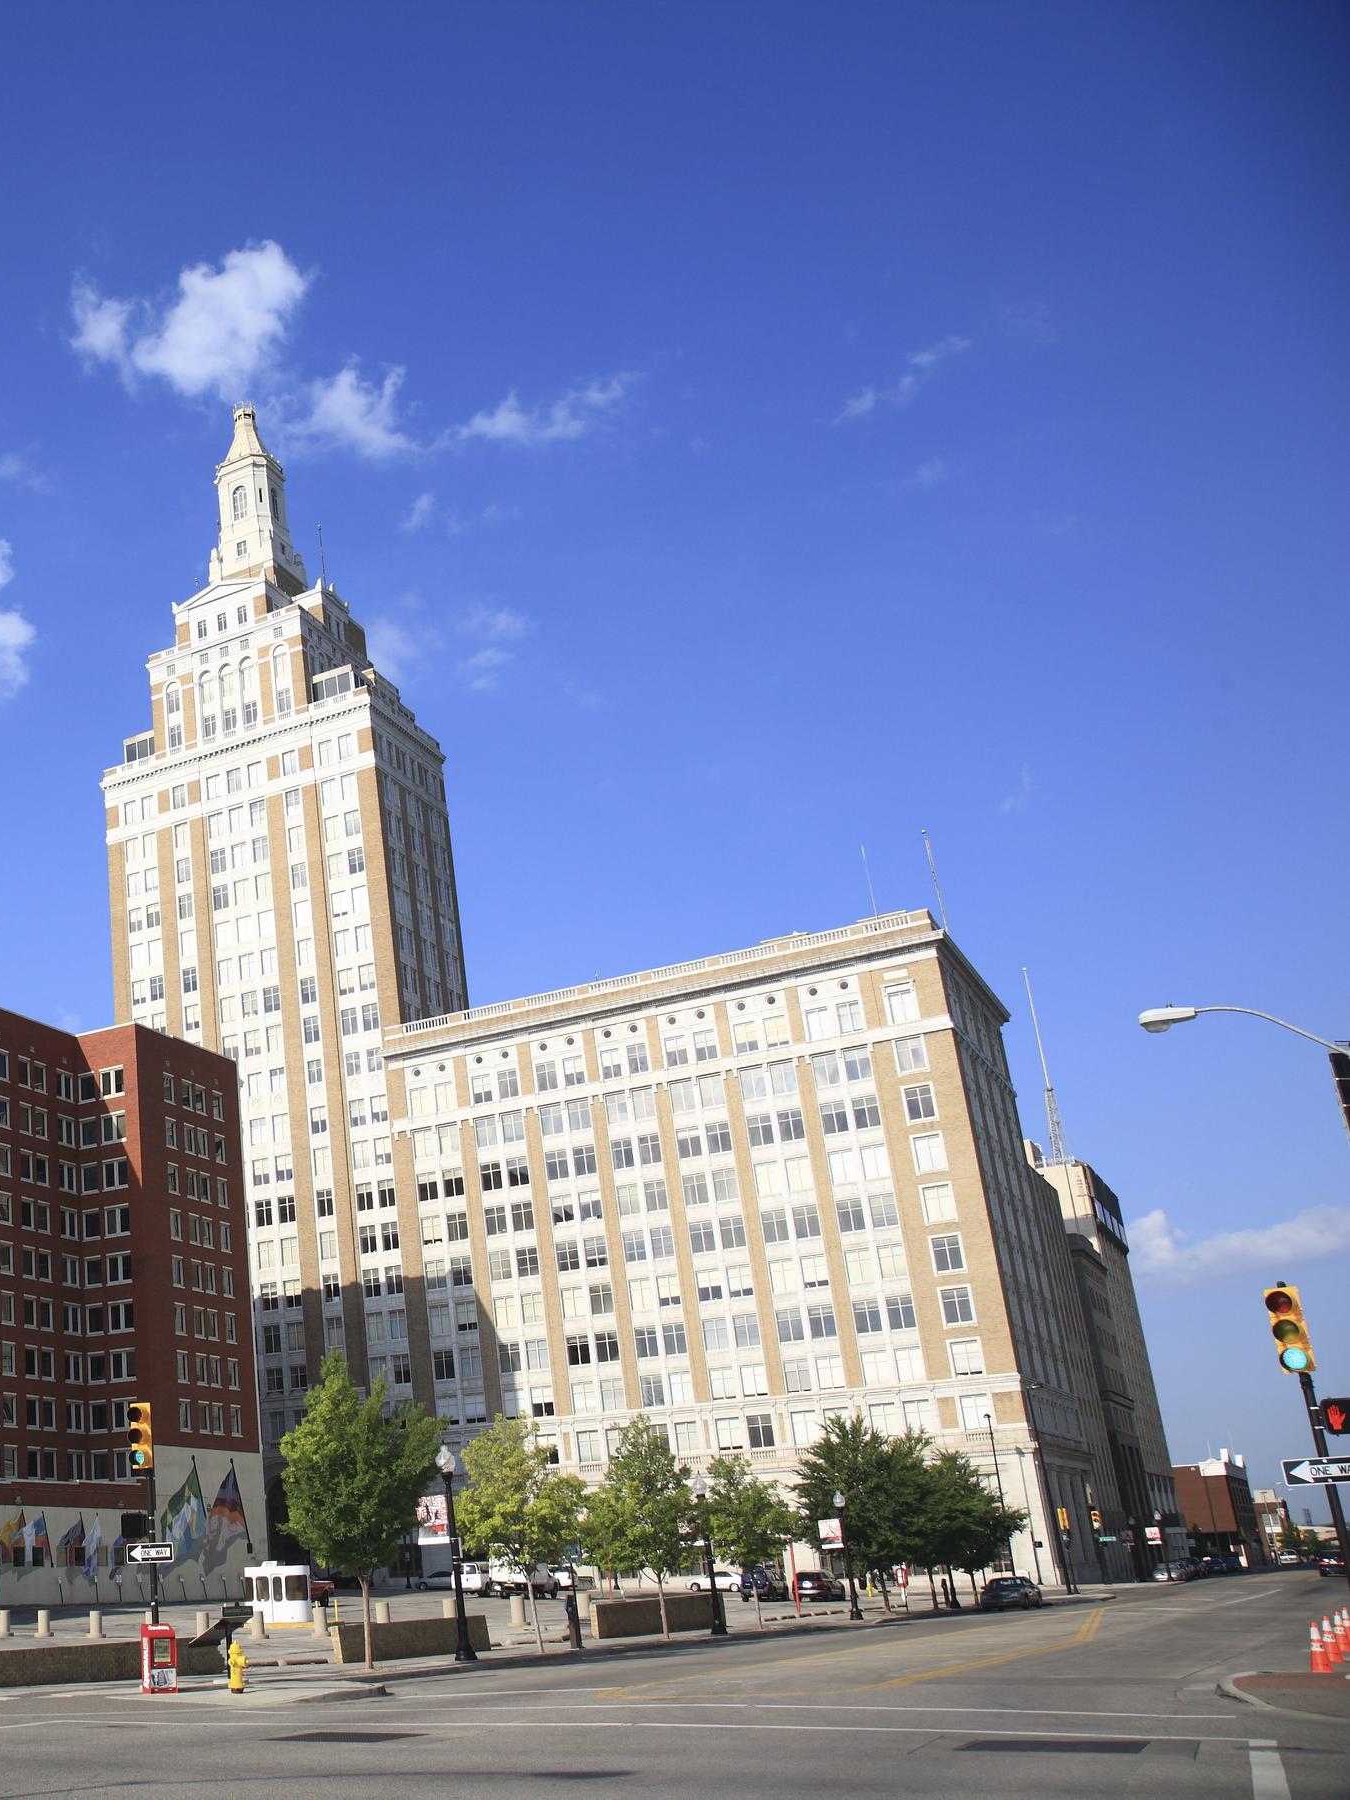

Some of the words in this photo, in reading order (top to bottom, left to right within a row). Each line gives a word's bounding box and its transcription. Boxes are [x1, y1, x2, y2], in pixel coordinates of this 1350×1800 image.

[1310, 1465, 1332, 1476] ONE
[140, 1549, 152, 1557] ONE
[155, 1548, 168, 1556] WAY
